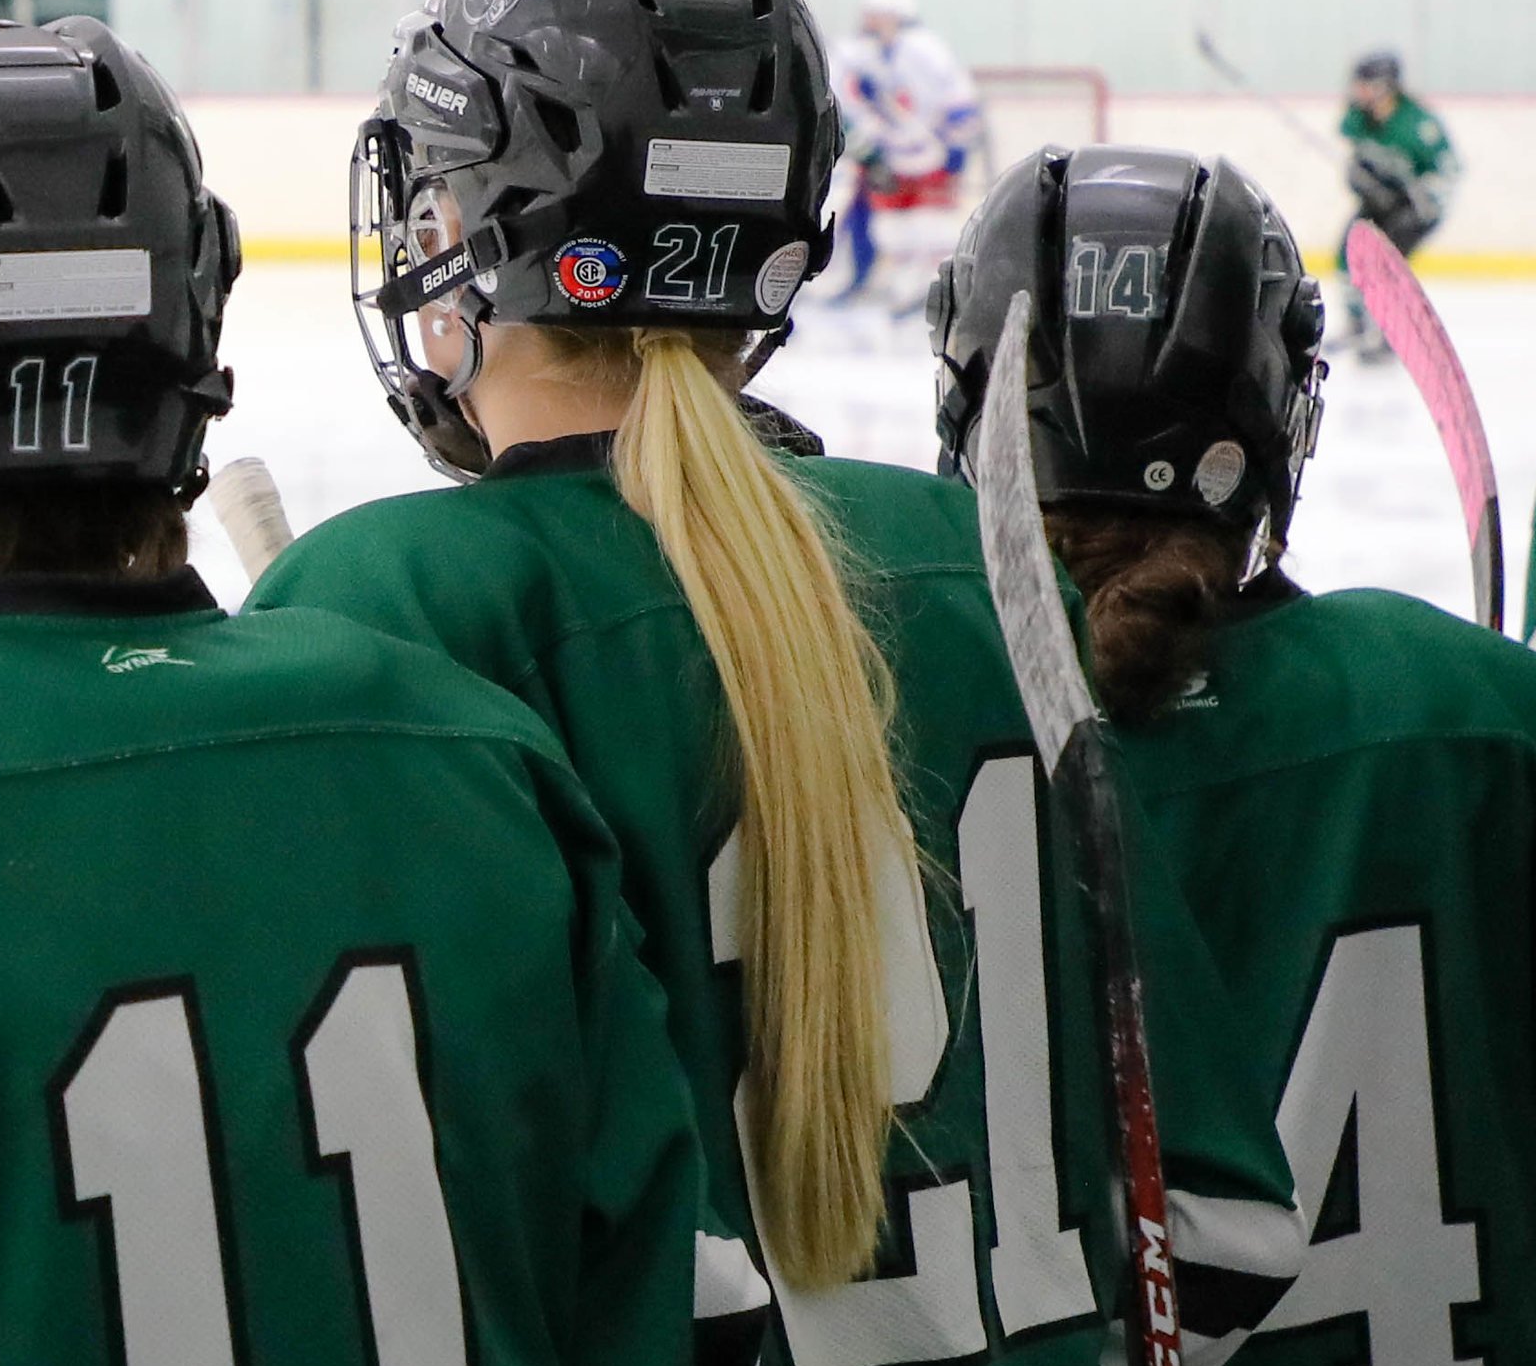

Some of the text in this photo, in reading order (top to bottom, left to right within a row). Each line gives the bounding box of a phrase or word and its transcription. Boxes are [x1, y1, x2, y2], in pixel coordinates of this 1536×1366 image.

[405, 72, 469, 116] BAUER
[576, 288, 605, 299] 2019
[645, 224, 740, 300] 21
[1071, 246, 1154, 318] 14
[10, 357, 98, 452] 11
